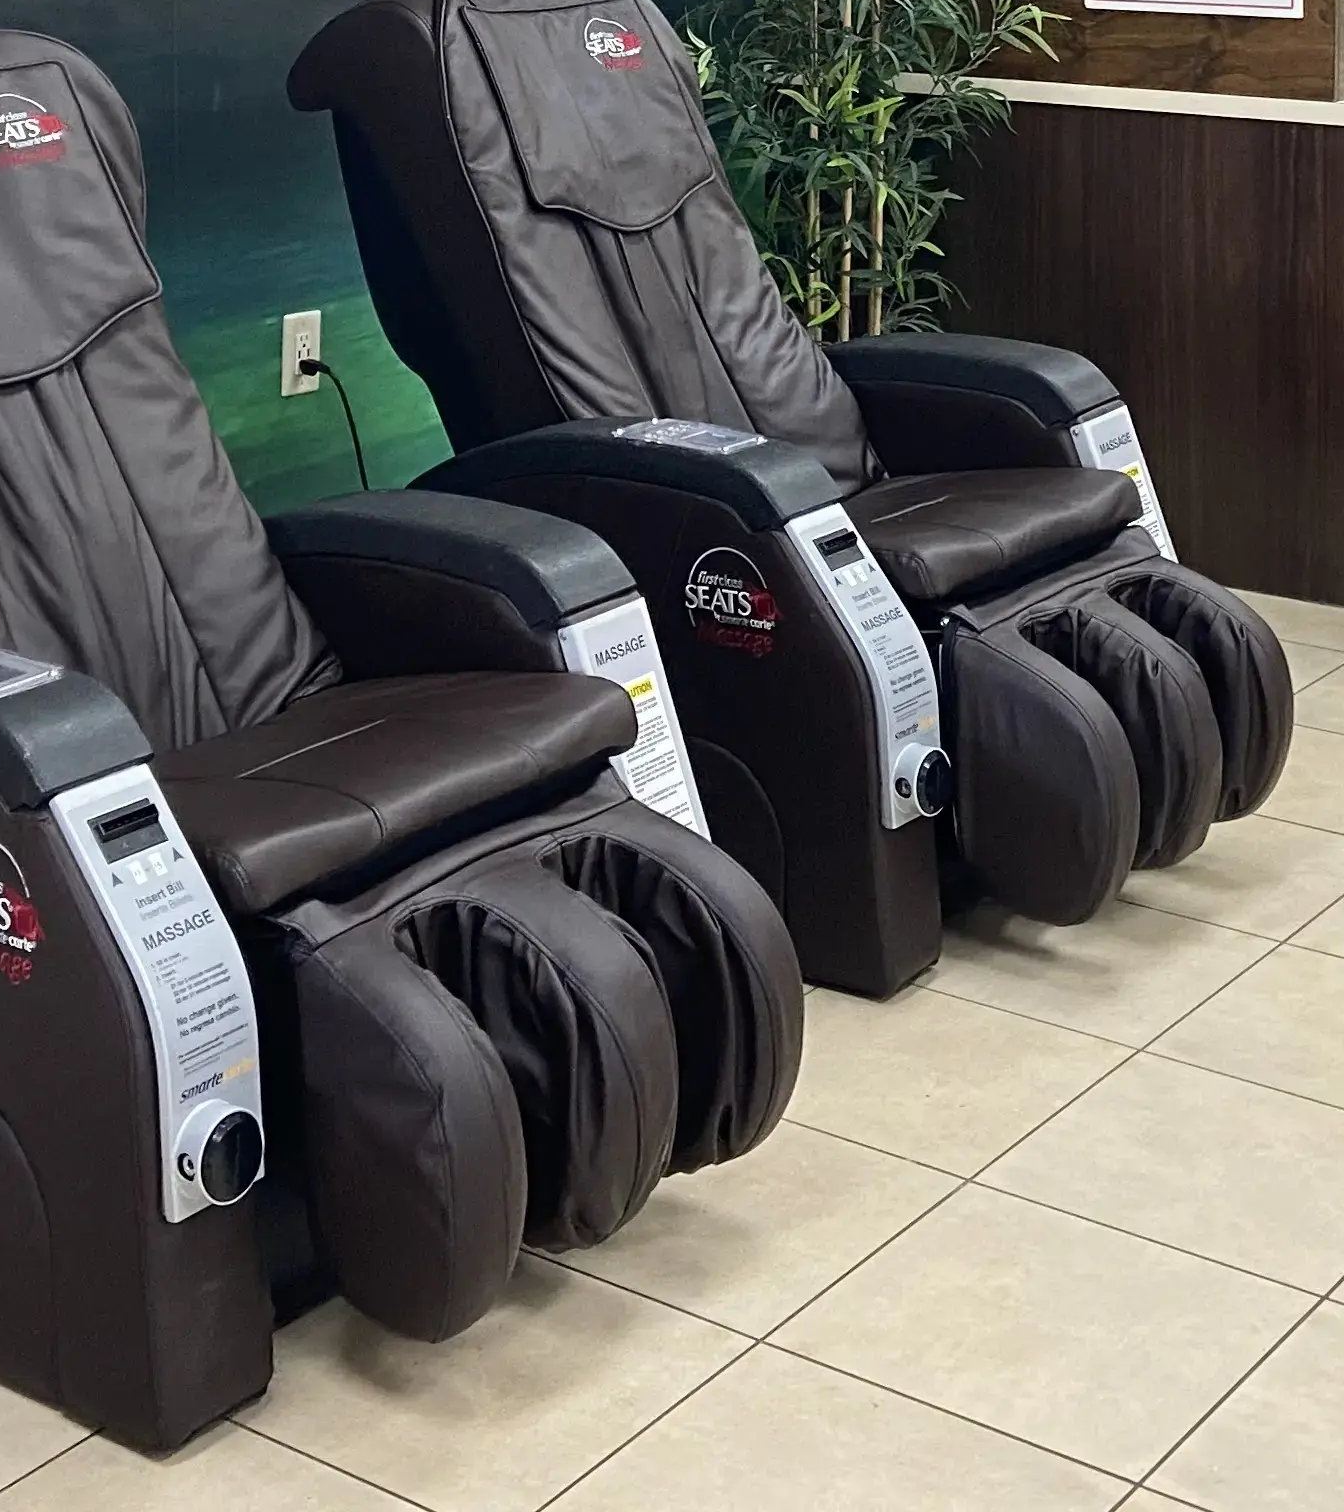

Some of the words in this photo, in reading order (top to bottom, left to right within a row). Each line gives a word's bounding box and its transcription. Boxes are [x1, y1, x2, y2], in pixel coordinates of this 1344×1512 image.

[1099, 432, 1133, 455] MASSAGE
[685, 584, 752, 616] SEATS
[861, 607, 904, 632] MASSAGE
[595, 634, 647, 666] MASSAGE
[629, 681, 653, 697] UTION
[134, 890, 166, 909] Insert
[166, 880, 185, 897] Bill
[141, 908, 215, 952] MASSAGE
[176, 1015, 188, 1027] No
[189, 1003, 216, 1022] change
[179, 1027, 190, 1038] No
[179, 1071, 224, 1104] smarte
